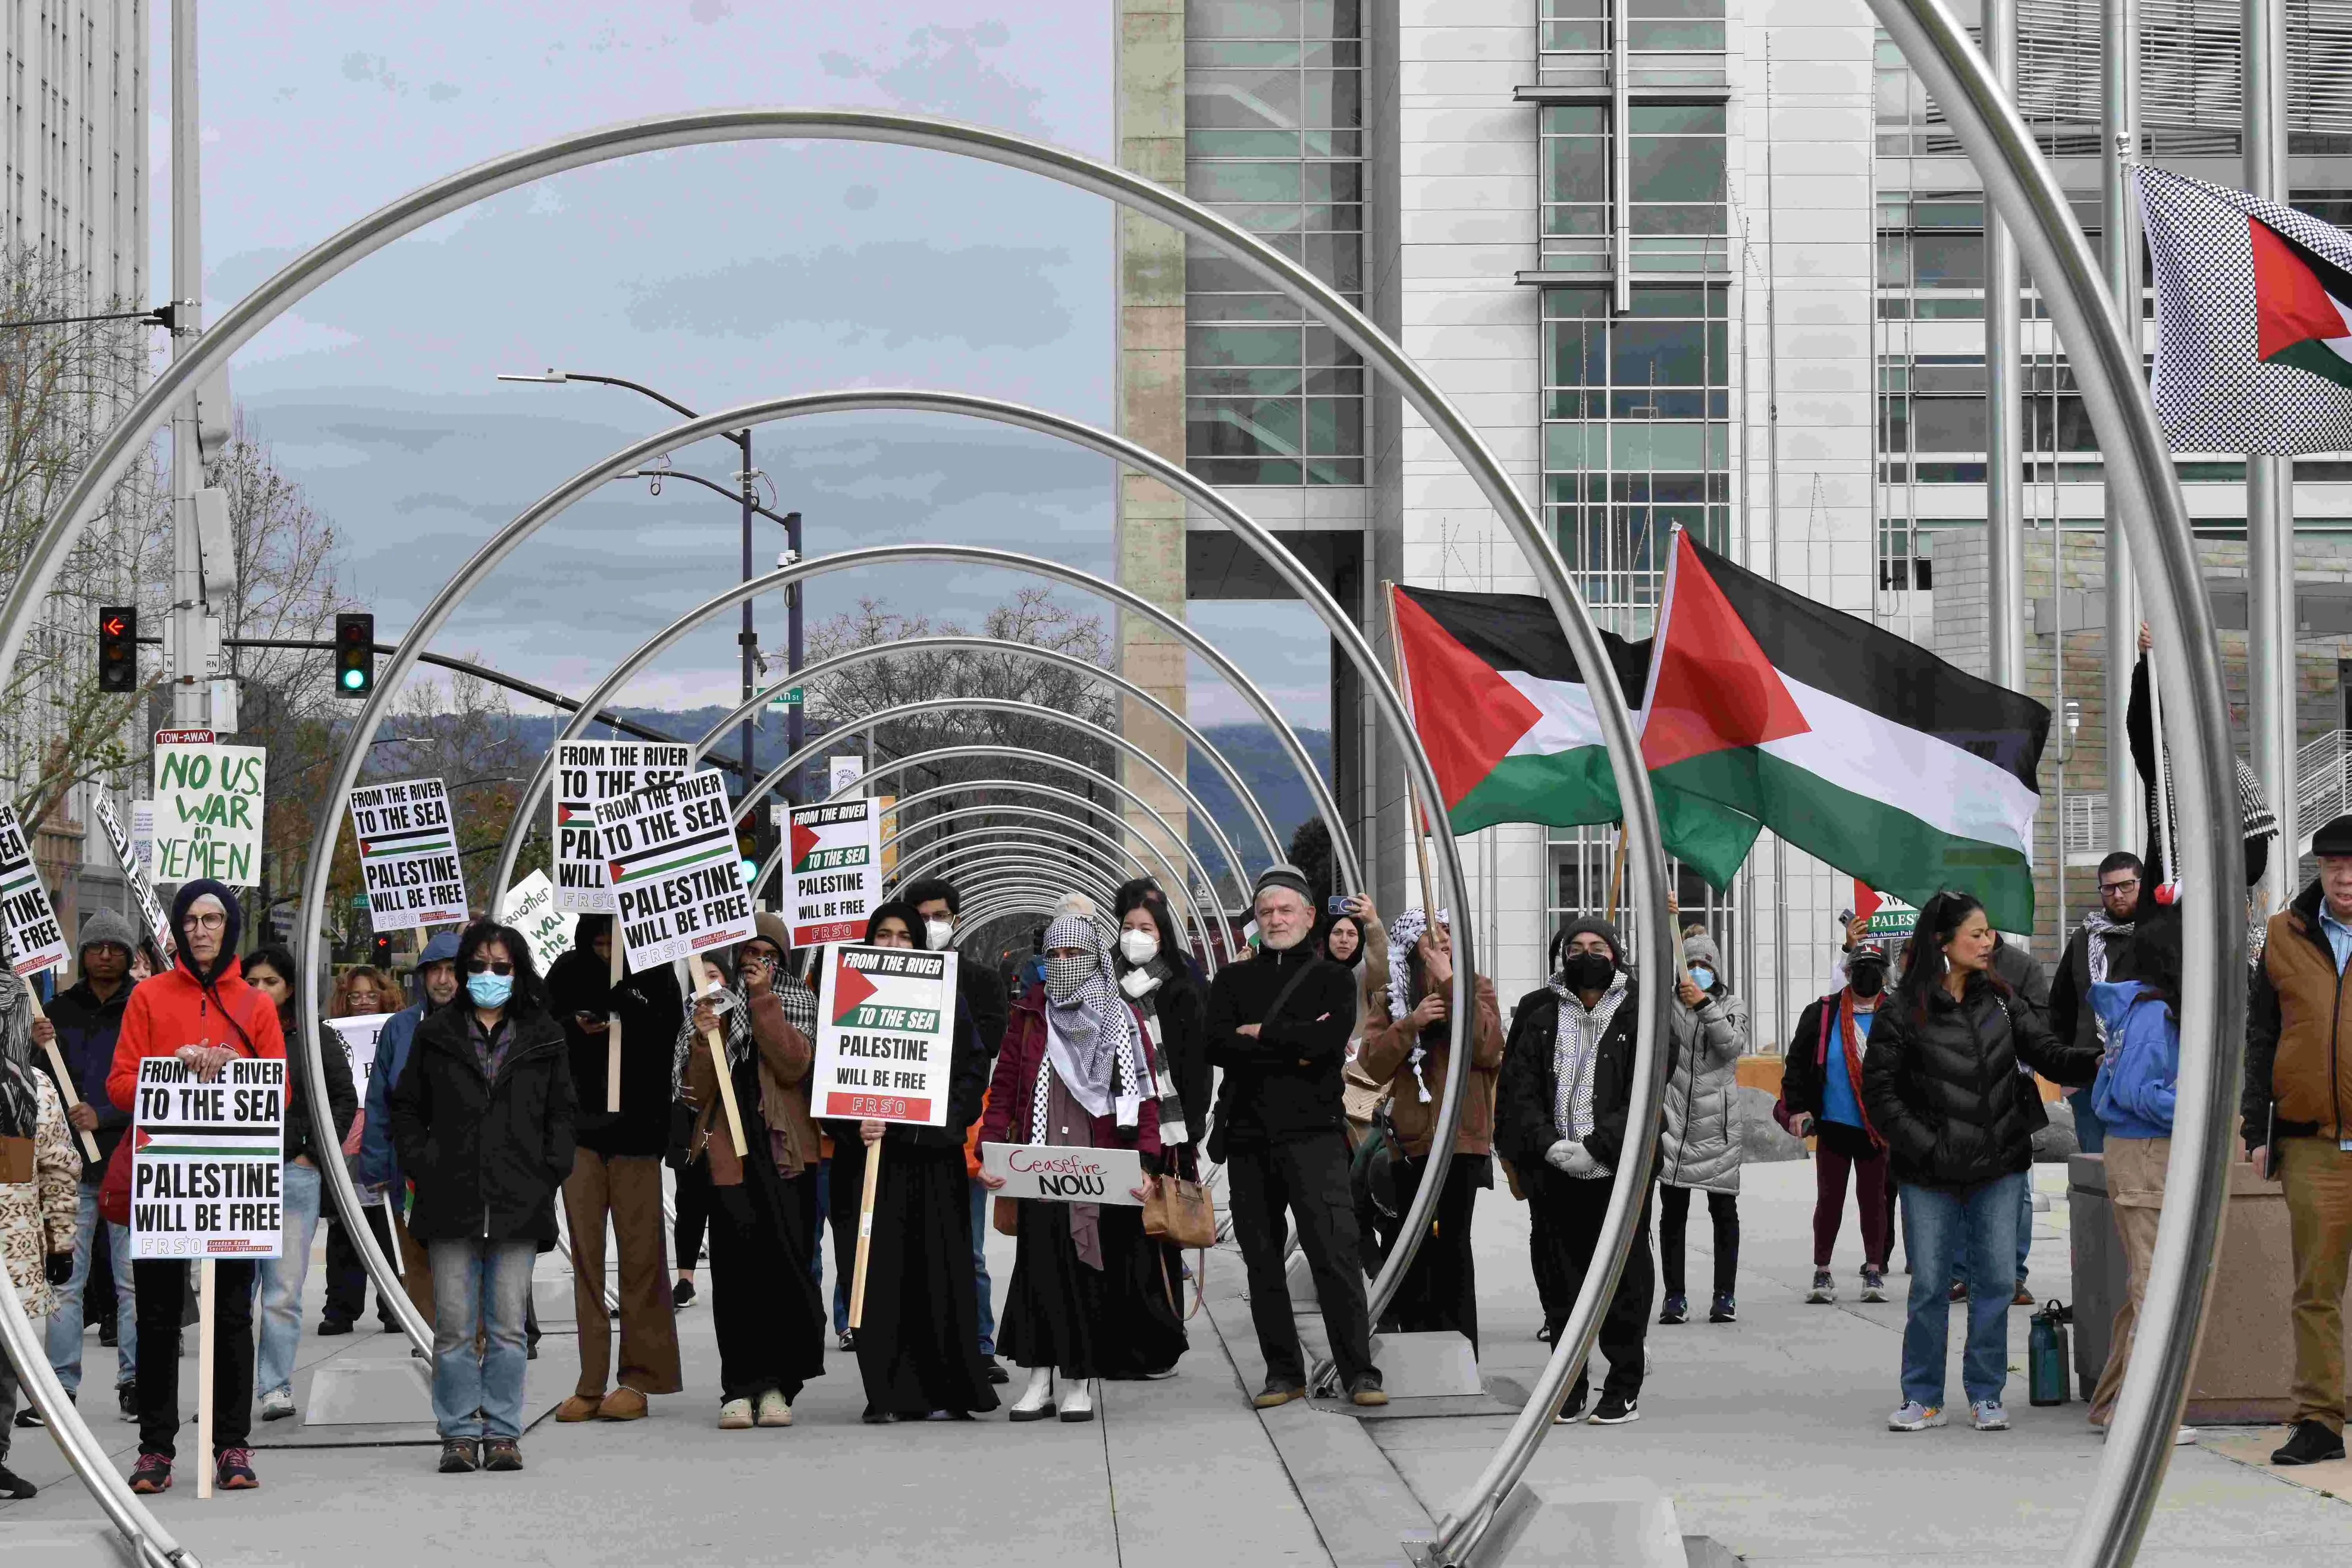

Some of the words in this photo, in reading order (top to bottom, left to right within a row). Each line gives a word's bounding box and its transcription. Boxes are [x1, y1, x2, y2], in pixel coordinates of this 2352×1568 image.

[160, 732, 209, 743] TOW-AWAY
[560, 746, 604, 766] FROM
[610, 747, 638, 766] THE
[644, 747, 688, 766] RIVER
[160, 752, 212, 790] NO
[221, 756, 262, 797] U.S.
[561, 770, 587, 798] TO
[596, 771, 635, 798] THE
[351, 789, 384, 808] FROM
[385, 786, 407, 804] THE
[409, 782, 444, 801] RIVER
[595, 792, 642, 825] FROM
[644, 786, 674, 811] THE
[676, 773, 721, 802] RIVER
[176, 793, 253, 830] WAR
[356, 810, 377, 834] TO
[379, 806, 411, 831] THE
[414, 800, 447, 826] SEA
[793, 810, 819, 826] FROM
[821, 808, 838, 822] THE
[839, 804, 866, 819] RIVER
[194, 822, 212, 840] in
[602, 824, 633, 855] TO
[636, 809, 680, 846] THE
[683, 797, 728, 832] SEA
[0, 828, 25, 860] EA
[157, 838, 251, 880] YEMEN
[809, 853, 821, 869] TO
[824, 851, 843, 867] THE
[845, 848, 866, 864] SEA
[366, 855, 459, 890] PALESTINE
[559, 864, 604, 888] WILL
[798, 873, 864, 897] PALESTINE
[370, 891, 405, 912] WILL
[407, 888, 426, 908] BE
[428, 884, 463, 906] FREE
[618, 861, 743, 922] PALESTINE
[505, 887, 549, 925] another
[799, 904, 821, 920] WILL
[824, 902, 837, 916] BE
[840, 900, 865, 915] FREE
[624, 917, 672, 949] WILL
[675, 907, 701, 936] BE
[703, 894, 750, 927] FREE
[812, 924, 851, 939] FRSO
[1872, 914, 1920, 927] PALES
[19, 918, 61, 953] FREE
[539, 933, 568, 959] the
[842, 953, 880, 969] FROM
[882, 955, 906, 971] THE
[906, 957, 942, 975] RIVER
[857, 1007, 877, 1025] TO
[878, 1009, 906, 1028] THE
[907, 1011, 935, 1030] SEA
[839, 1034, 928, 1062] PALESTINE
[141, 1060, 188, 1083] FROM
[233, 1062, 283, 1084] RIVER
[837, 1067, 868, 1086] WILL
[873, 1070, 890, 1087] BE
[894, 1071, 926, 1090] FREE
[141, 1088, 170, 1120] TO
[179, 1089, 225, 1121] THE
[234, 1089, 280, 1122] SEA
[853, 1097, 906, 1114] FRSO
[1009, 1150, 1107, 1176] Ceasefire
[136, 1163, 279, 1198] PALESTINE
[1039, 1175, 1105, 1196] NOW
[135, 1204, 187, 1232] WILL
[195, 1204, 221, 1231] BE
[230, 1203, 280, 1231] FREE
[142, 1238, 201, 1254] FRSO
